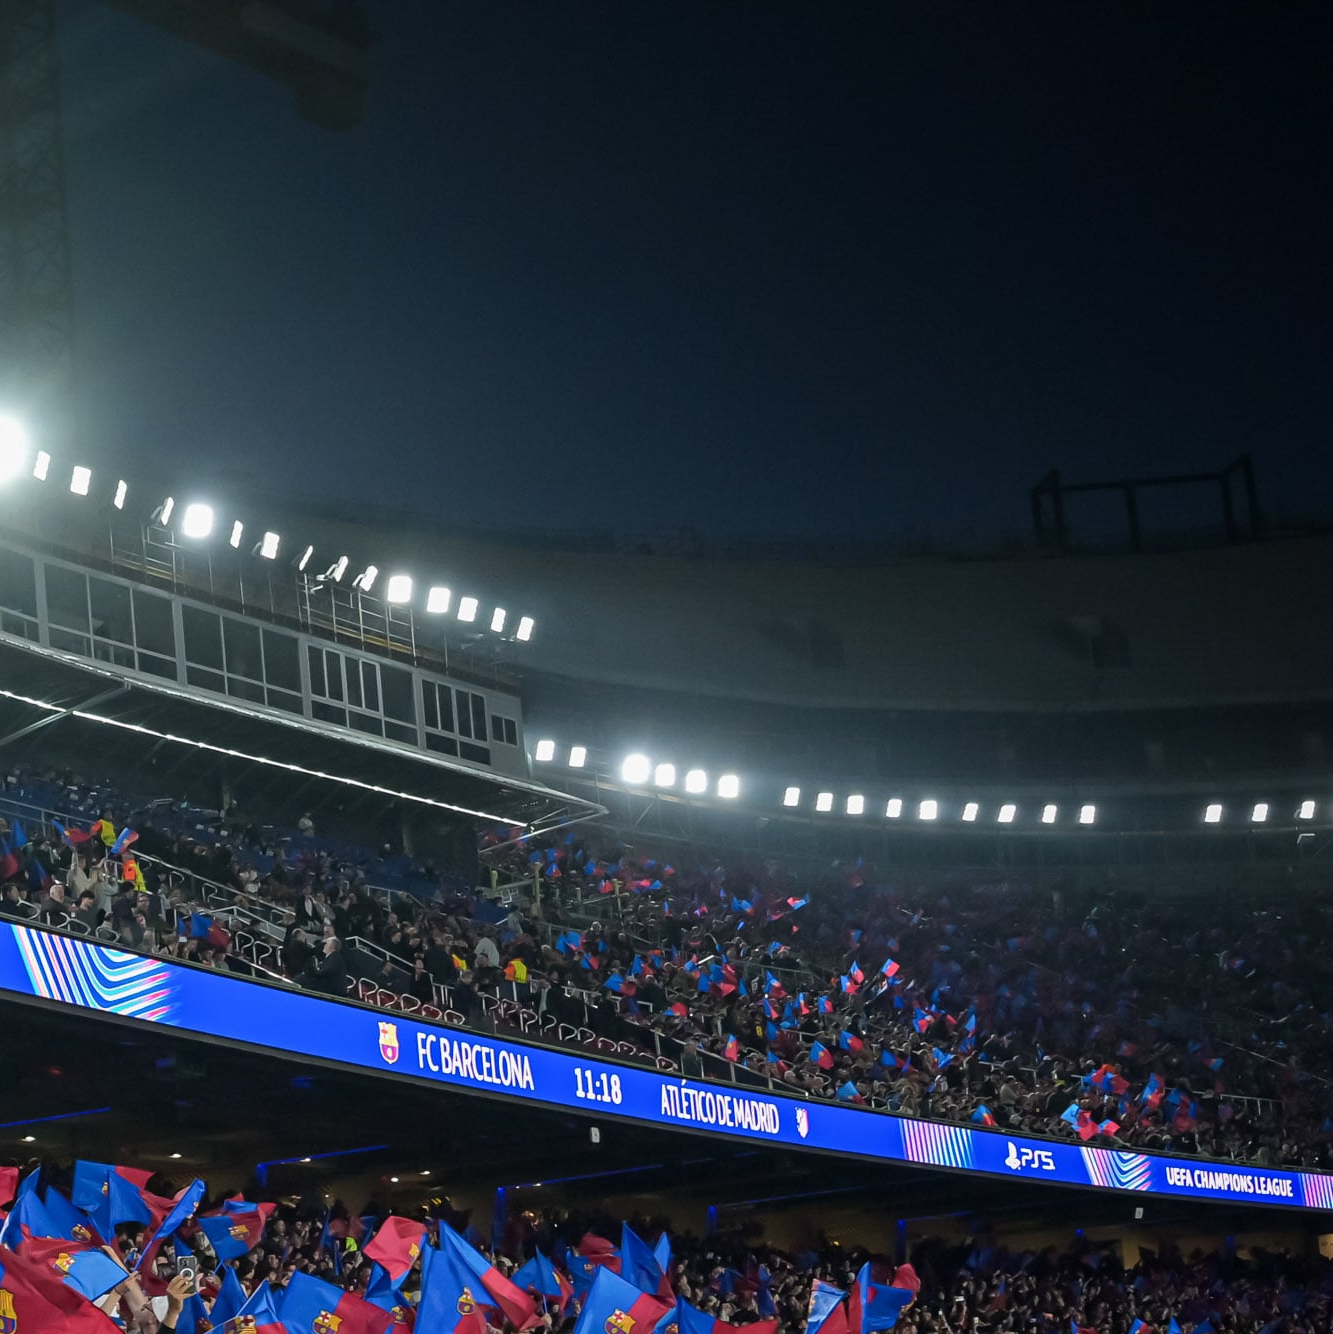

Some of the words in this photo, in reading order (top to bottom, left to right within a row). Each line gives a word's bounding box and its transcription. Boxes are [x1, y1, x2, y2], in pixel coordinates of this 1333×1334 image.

[416, 1032, 439, 1072] FC
[440, 1036, 535, 1090] BARCELONA
[574, 1067, 623, 1105] 11:18
[661, 1079, 717, 1124] ATLÉTICO
[716, 1094, 734, 1127] DE
[733, 1097, 780, 1134] MADRID
[1020, 1148, 1056, 1170] PS5
[1166, 1167, 1193, 1187] UEFA
[1194, 1169, 1254, 1194] CHAMPIONS
[1254, 1176, 1293, 1197] LEAGUE
